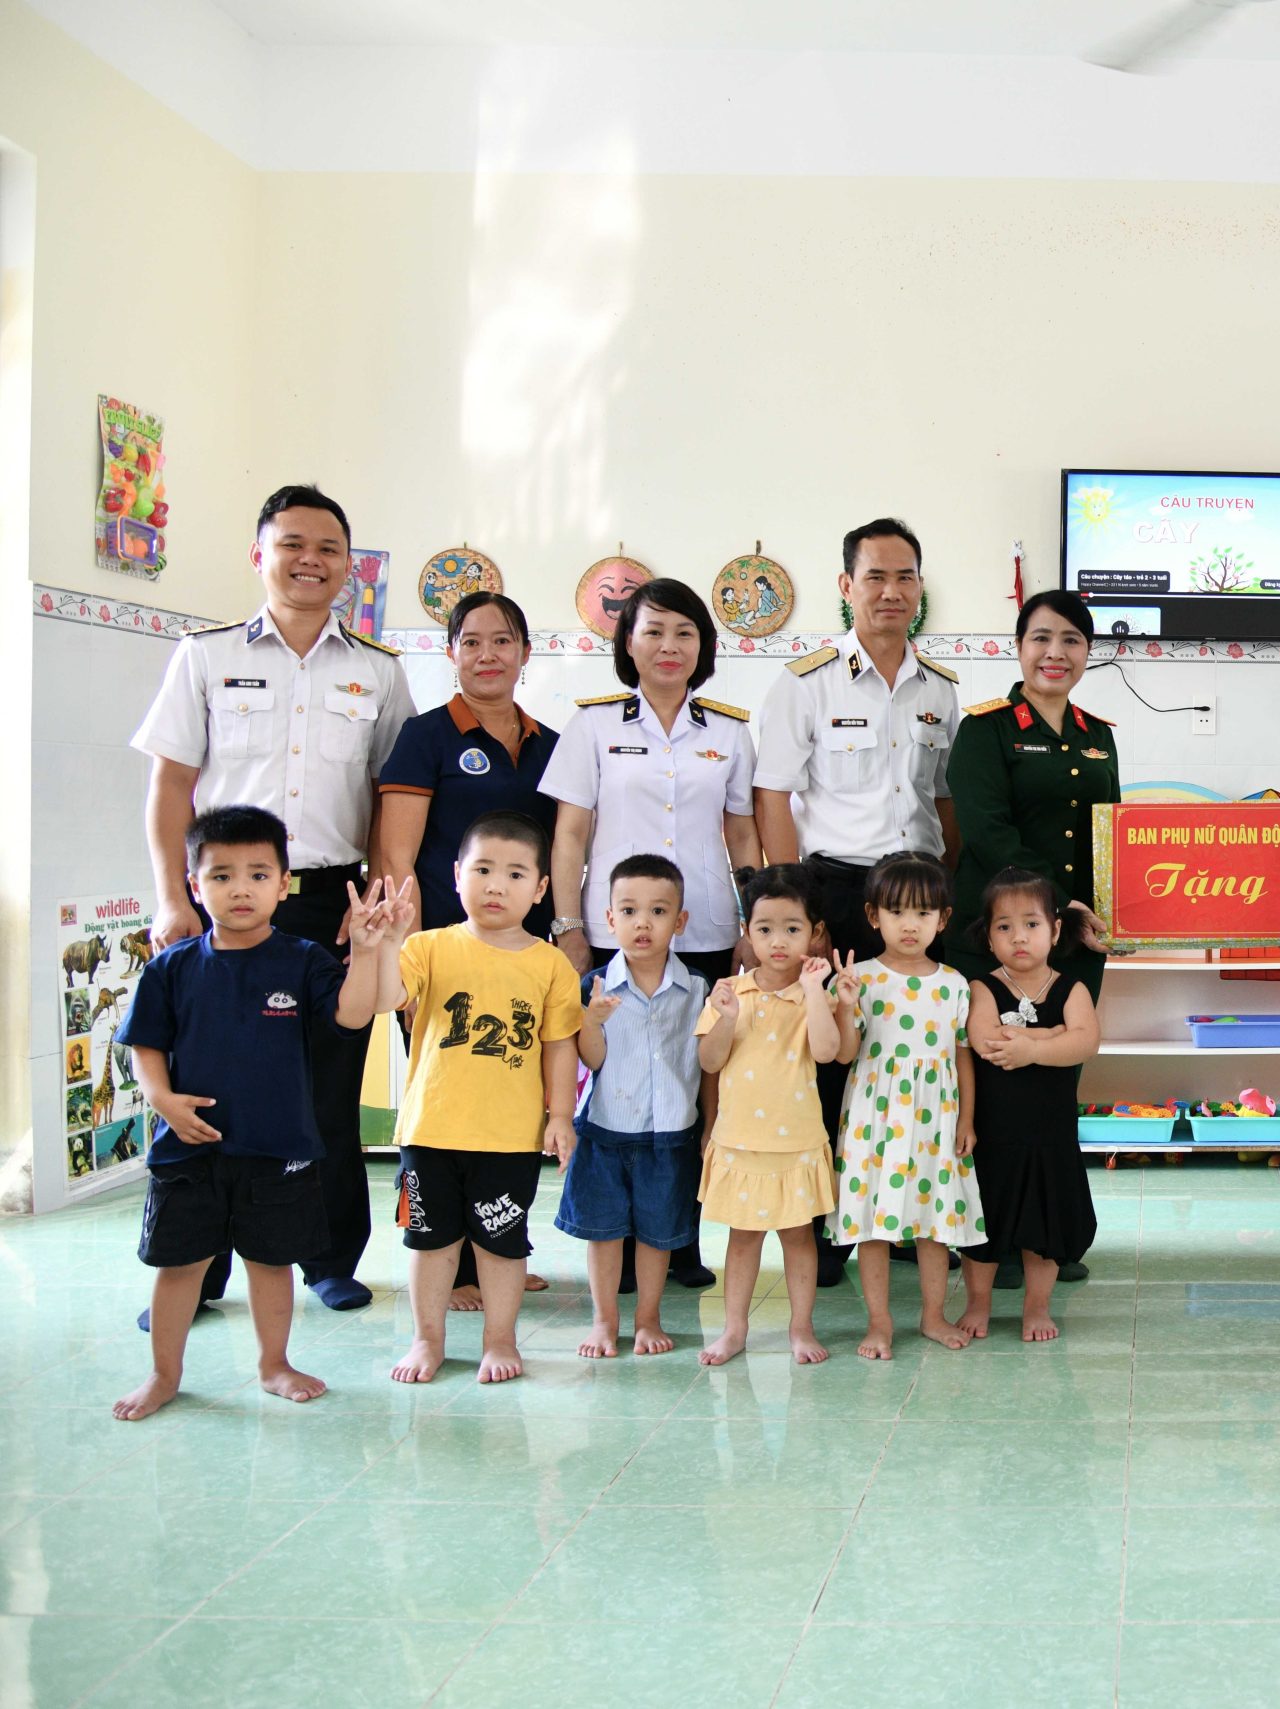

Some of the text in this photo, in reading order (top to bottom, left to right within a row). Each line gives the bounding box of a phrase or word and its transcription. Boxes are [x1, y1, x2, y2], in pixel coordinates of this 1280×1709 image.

[1127, 827, 1157, 844] BAN
[1161, 827, 1190, 848] PHỤ
[1194, 824, 1216, 844] NỮ
[1218, 824, 1258, 846] QUÂN
[1145, 863, 1268, 905] Tặng
[95, 897, 140, 919] wildlife
[84, 922, 105, 934] Động
[121, 917, 142, 928] hoang
